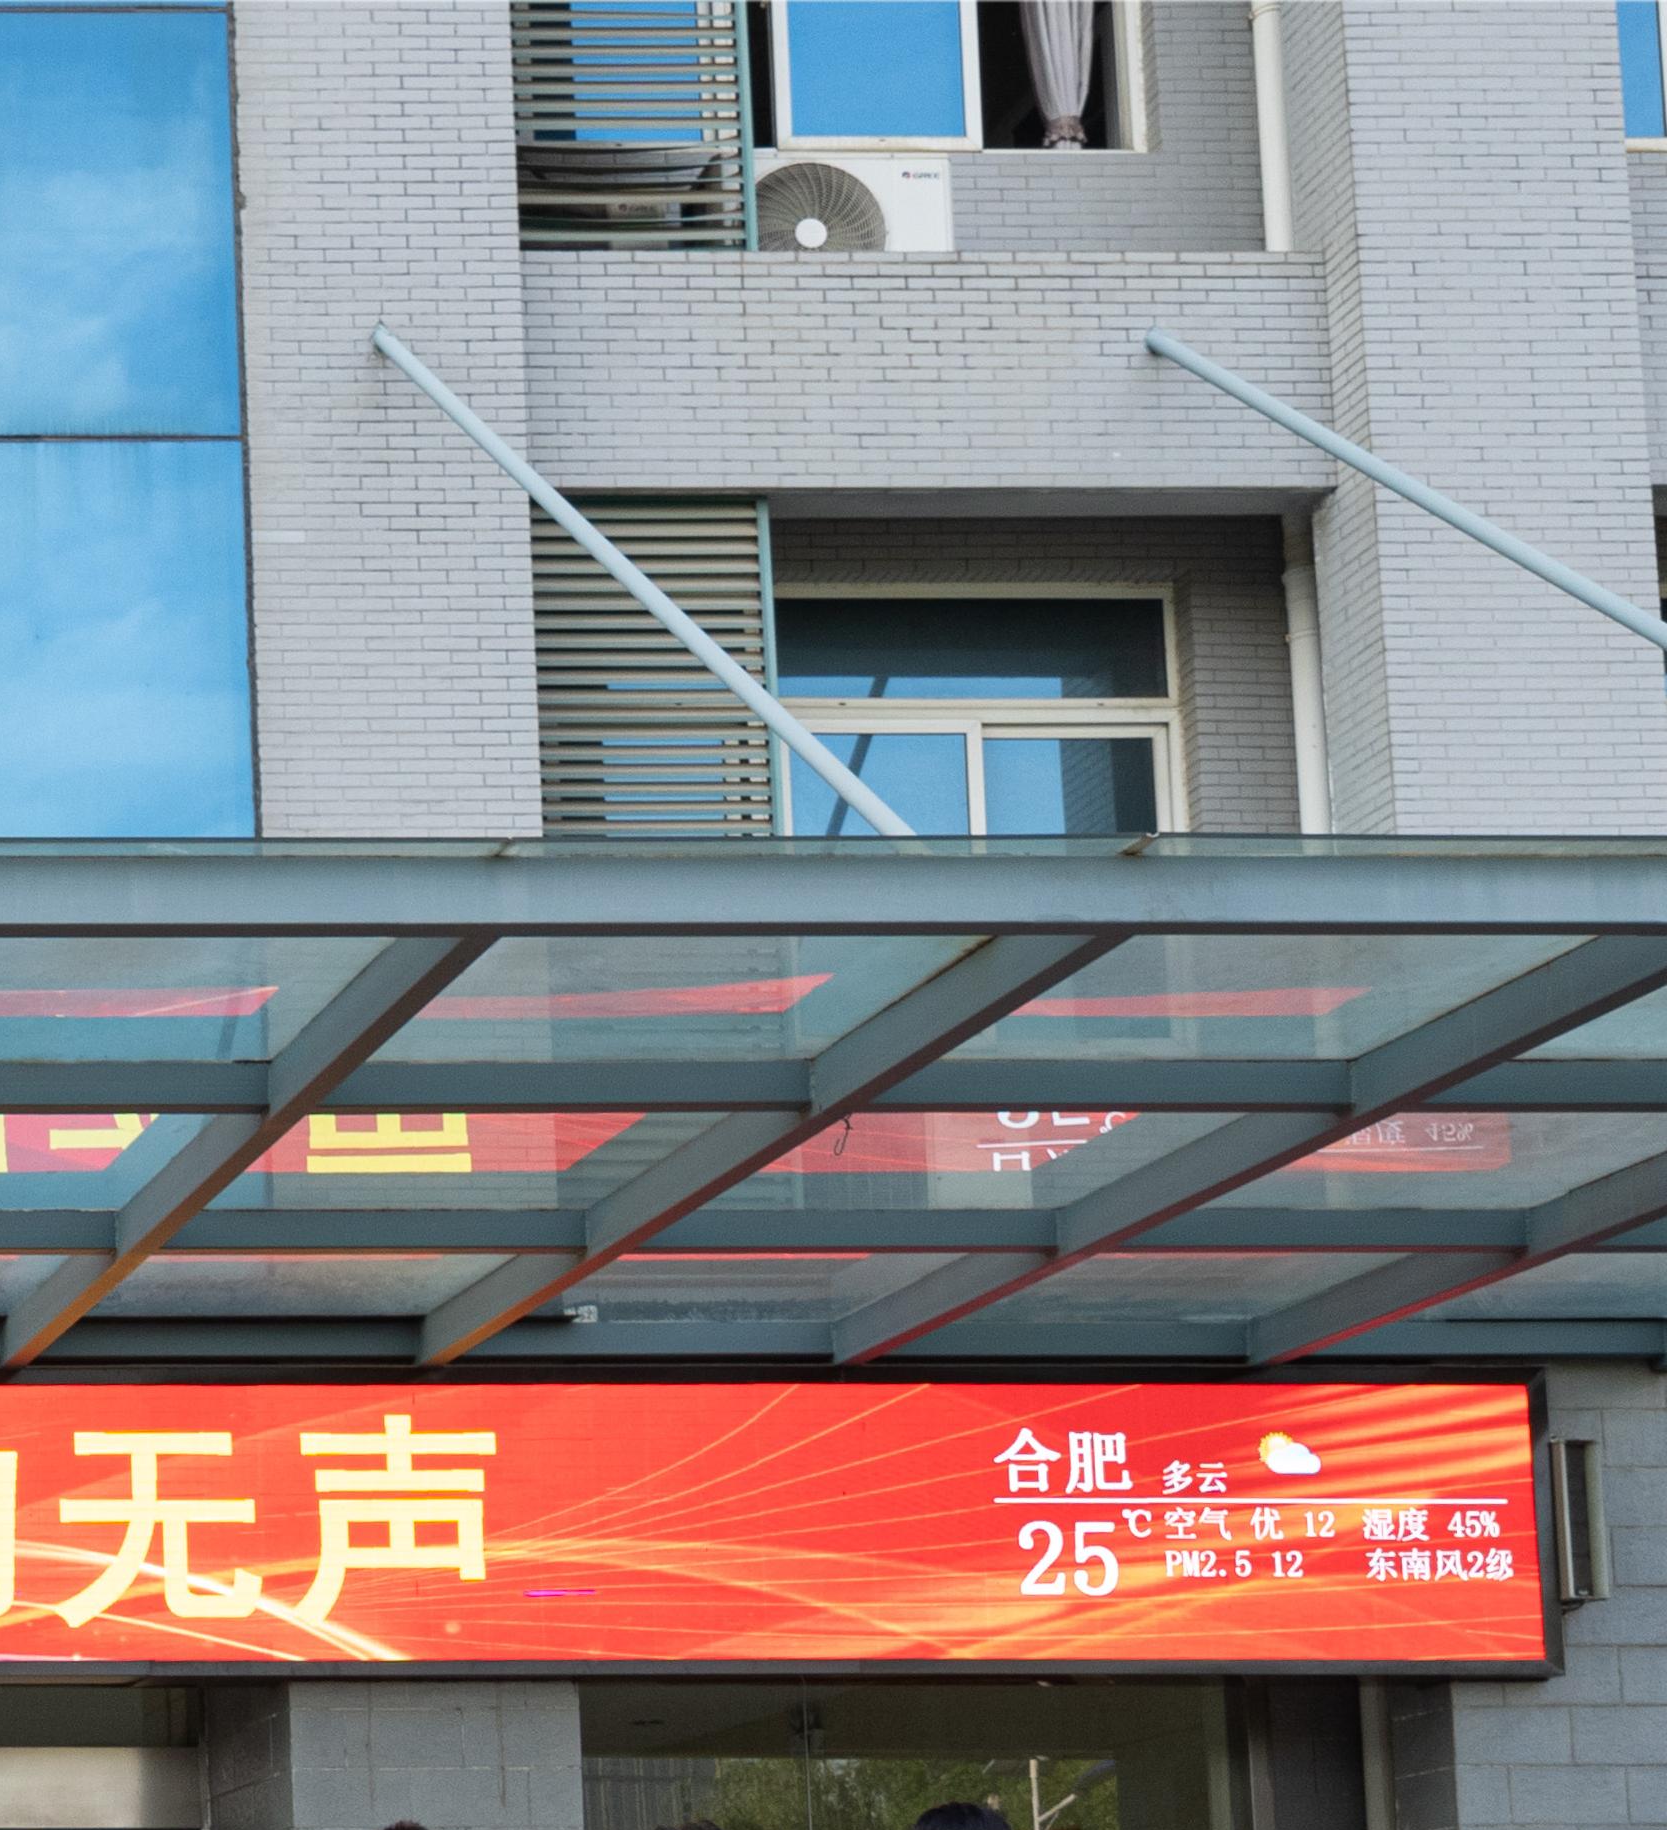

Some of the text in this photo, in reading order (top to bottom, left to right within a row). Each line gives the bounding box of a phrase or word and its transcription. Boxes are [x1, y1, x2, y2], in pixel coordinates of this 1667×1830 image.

[993, 1427, 1229, 1494] 合肥 多云
[1164, 1507, 1501, 1542] 空气 优 12 湿度 45%
[1165, 1547, 1515, 1581] PM2.5 12 东南风2级
